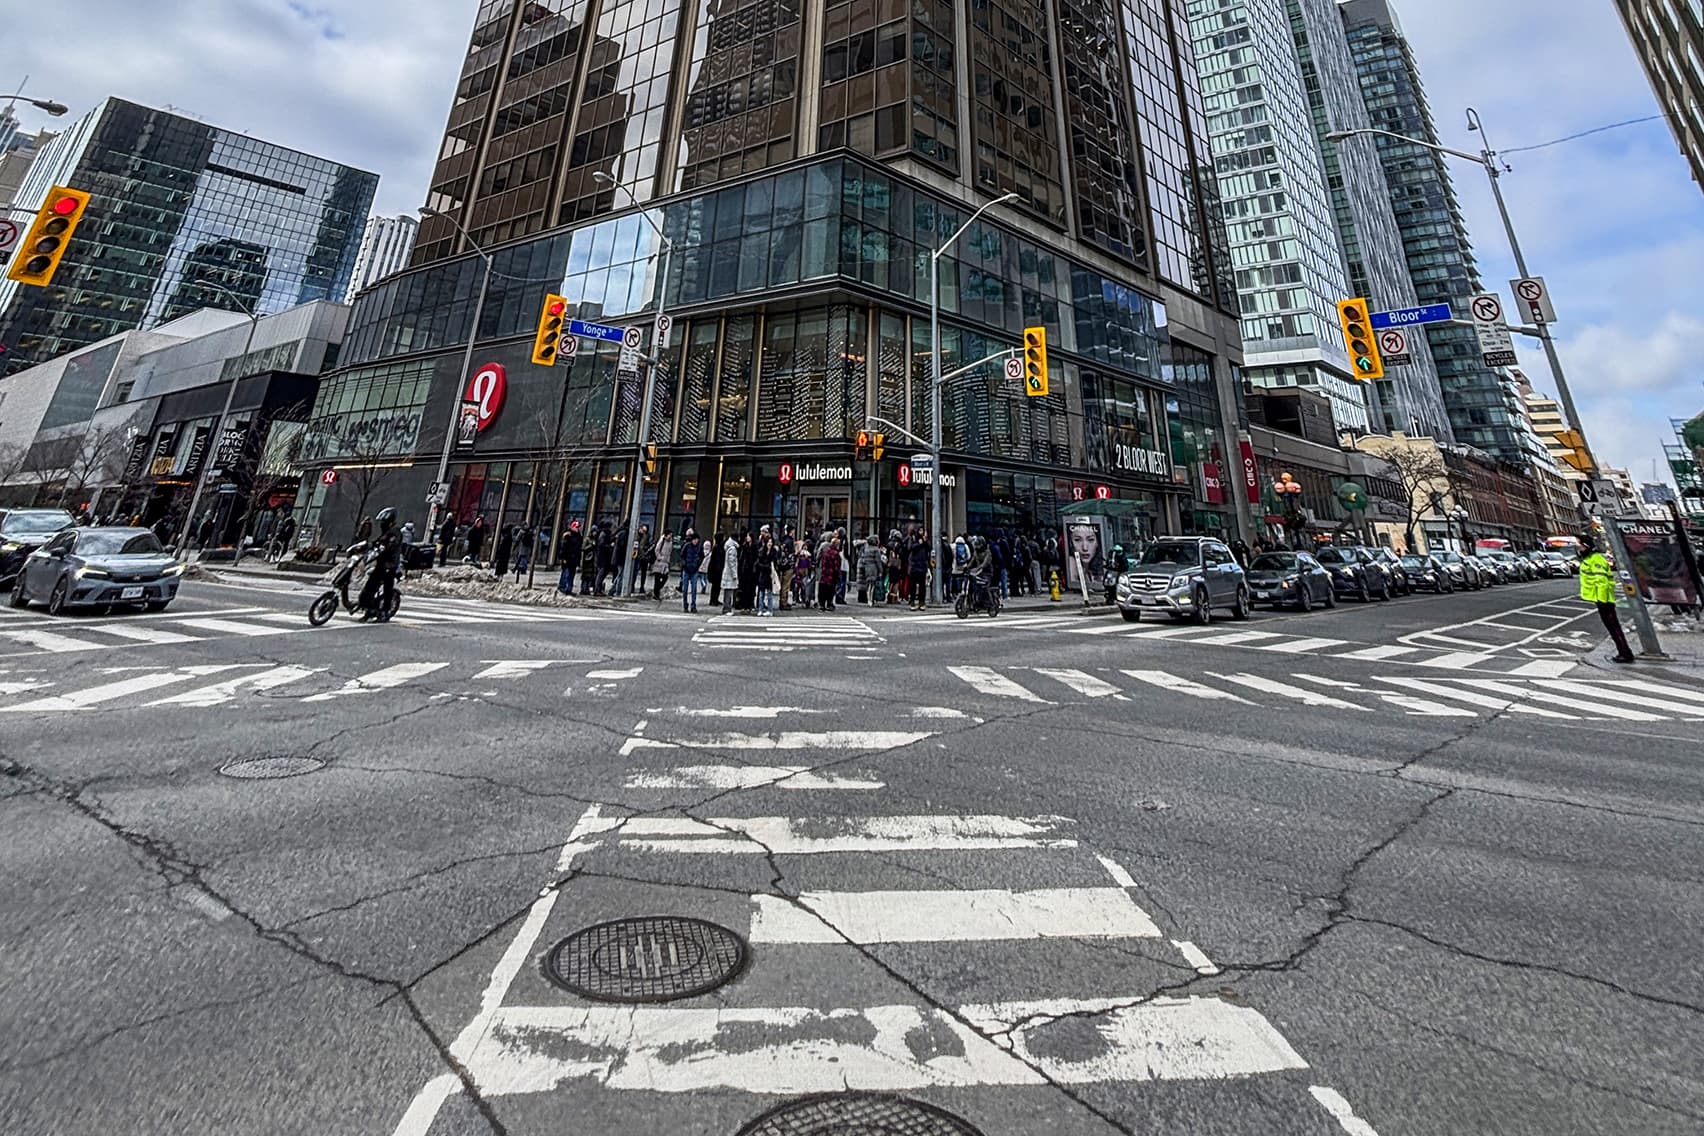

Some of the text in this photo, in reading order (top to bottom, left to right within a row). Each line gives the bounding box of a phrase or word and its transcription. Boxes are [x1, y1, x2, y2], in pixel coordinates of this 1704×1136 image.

[1389, 311, 1420, 324] Bloor
[582, 322, 607, 338] Yonge
[186, 434, 207, 474] ARITZIA
[1115, 443, 1168, 476] 2 BLOOR WEST
[795, 464, 853, 480] lululemon
[1622, 523, 1671, 535] CHANEL
